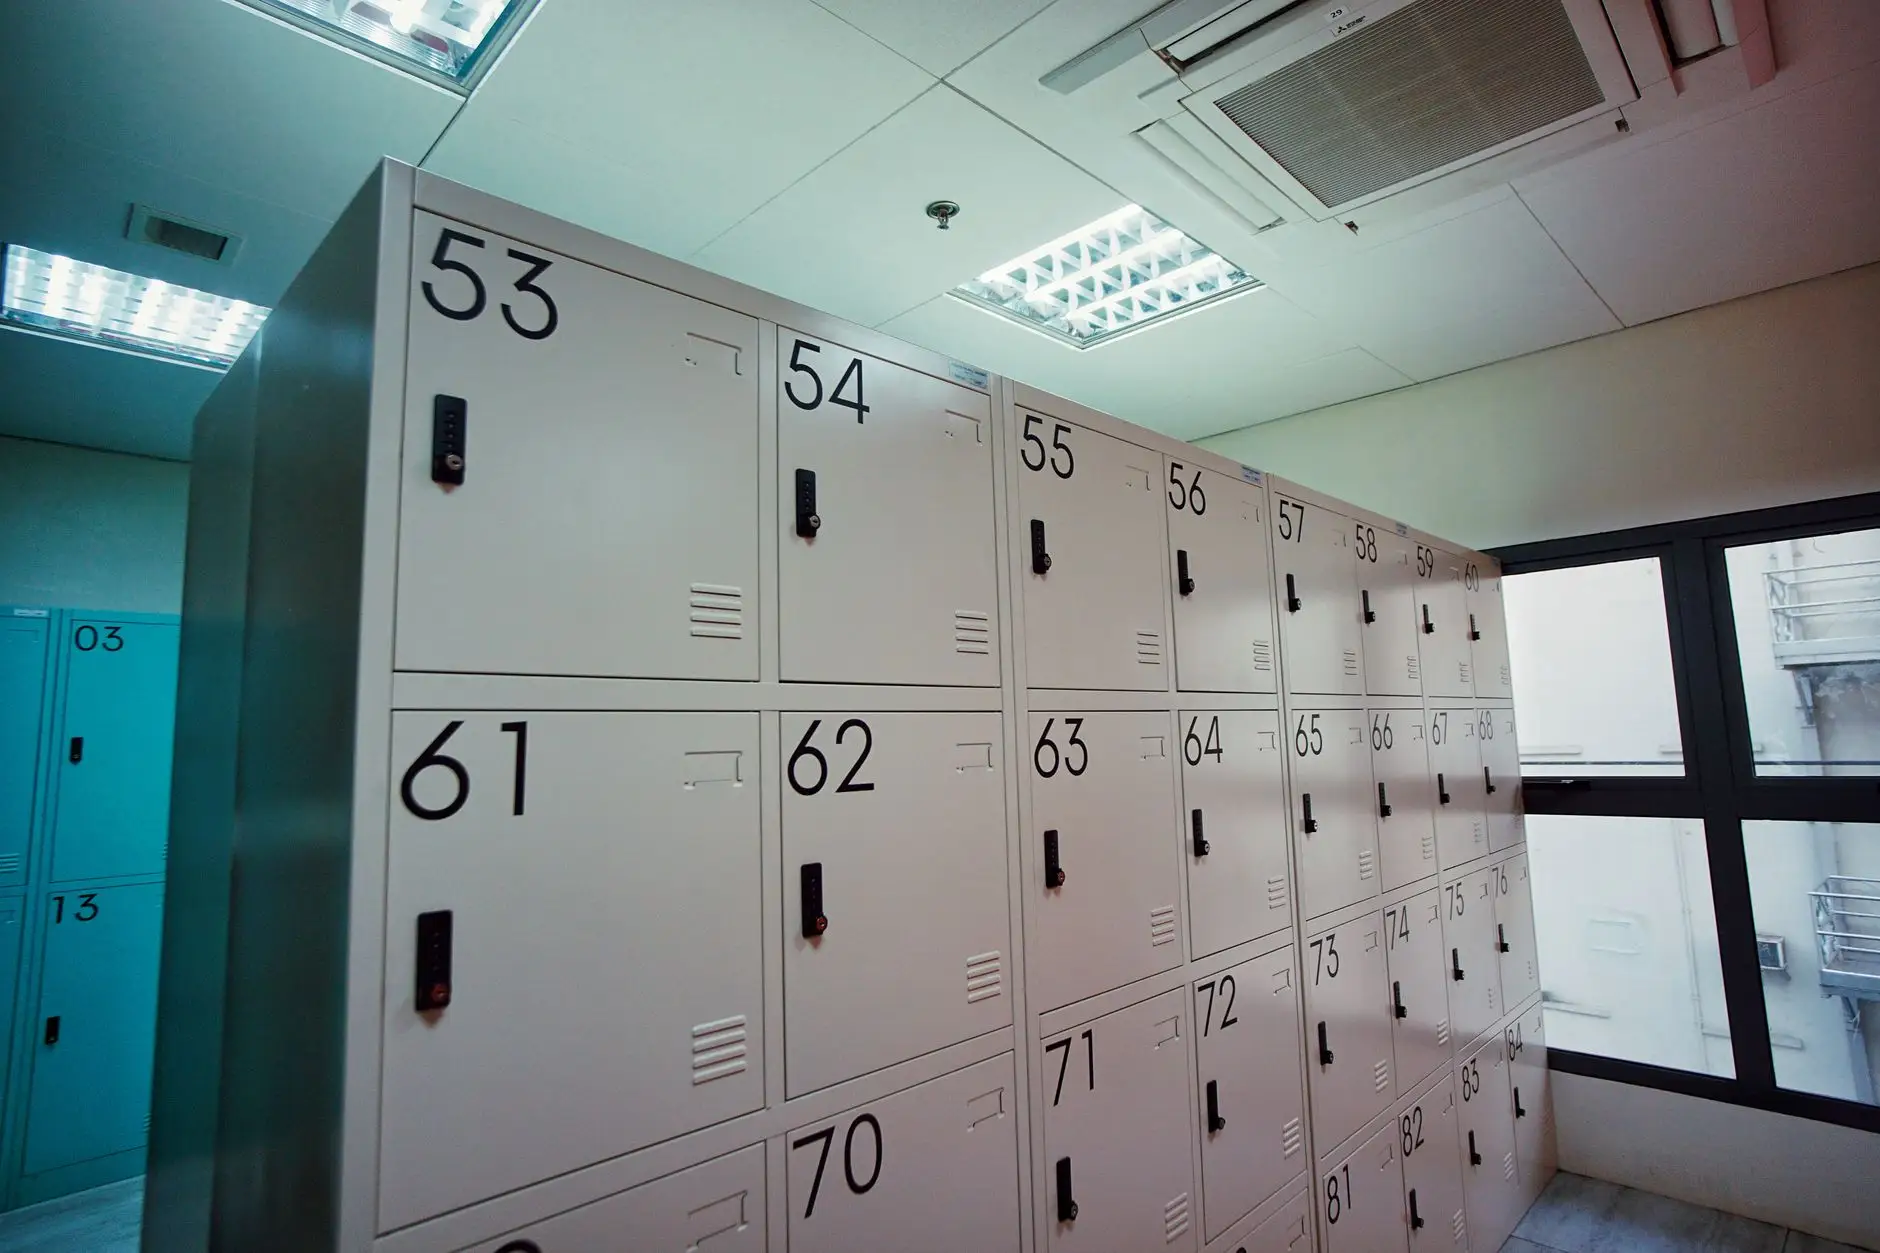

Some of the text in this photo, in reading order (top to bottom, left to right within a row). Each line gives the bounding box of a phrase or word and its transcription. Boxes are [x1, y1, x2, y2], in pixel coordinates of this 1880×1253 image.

[1330, 9, 1343, 18] 29
[421, 228, 558, 340] 53
[784, 339, 870, 424] 54
[1021, 414, 1074, 479] 55
[1168, 462, 1206, 516] 56
[1278, 499, 1304, 543] 57
[1356, 524, 1377, 563] 58
[1417, 545, 1434, 578] 59
[1465, 561, 1479, 592] 60
[74, 625, 124, 652] 03
[1183, 715, 1223, 766] 64
[1295, 713, 1323, 757] 65
[1371, 712, 1393, 750] 66
[1432, 712, 1447, 745] 67
[1479, 710, 1493, 740] 68
[787, 719, 874, 796] 62
[1033, 717, 1088, 778] 63
[400, 721, 527, 820] 61
[1445, 882, 1465, 920] 75
[1492, 865, 1508, 898] 76
[51, 894, 99, 925] 13
[1386, 905, 1410, 950] 74
[1310, 934, 1339, 986] 73
[1197, 974, 1238, 1037] 72
[1508, 1022, 1523, 1061] 84
[1045, 1029, 1095, 1106] 71
[1462, 1058, 1479, 1102] 83
[1402, 1106, 1424, 1157] 82
[792, 1113, 882, 1219] 70
[1327, 1164, 1351, 1224] 81
